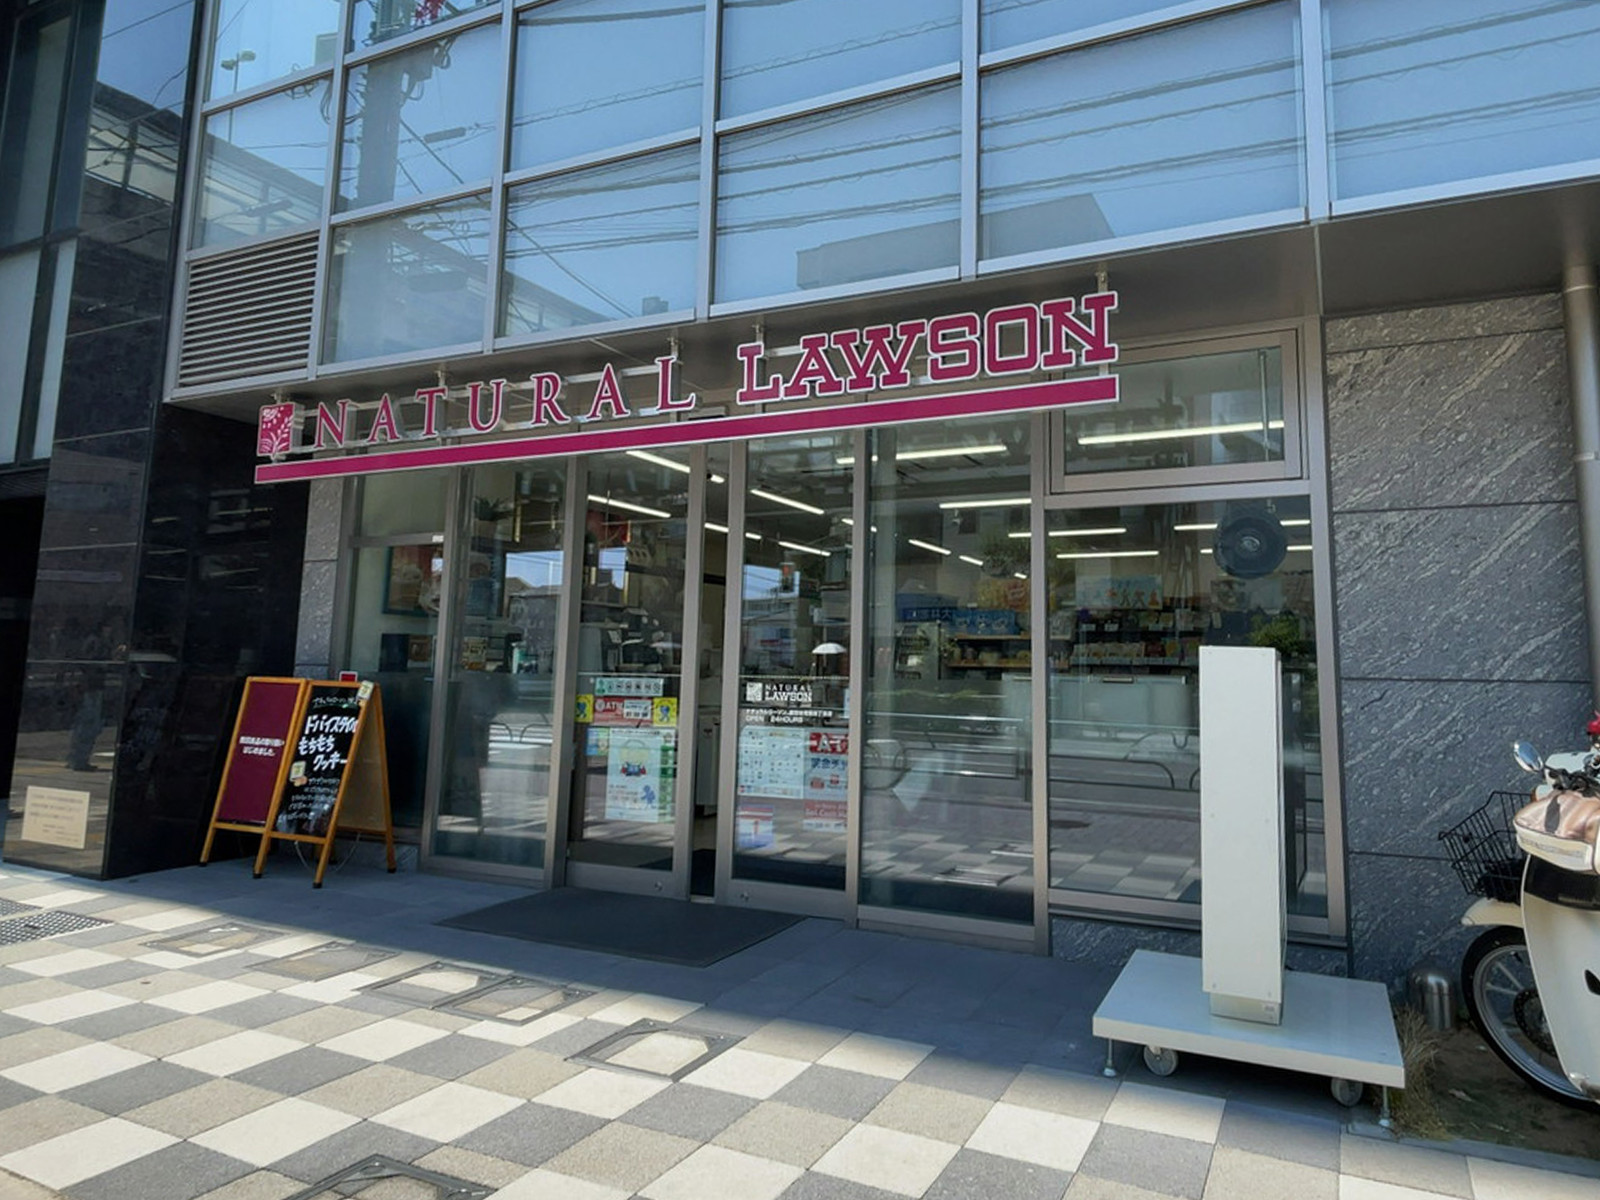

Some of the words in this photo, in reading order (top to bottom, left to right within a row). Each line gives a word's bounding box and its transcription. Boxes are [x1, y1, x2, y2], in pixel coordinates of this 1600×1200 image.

[314, 356, 696, 448] NATURAL
[737, 291, 1118, 404] LAWSON
[764, 691, 812, 701] LAWSON
[298, 734, 335, 755] もちもち
[313, 751, 348, 771] クッキー
